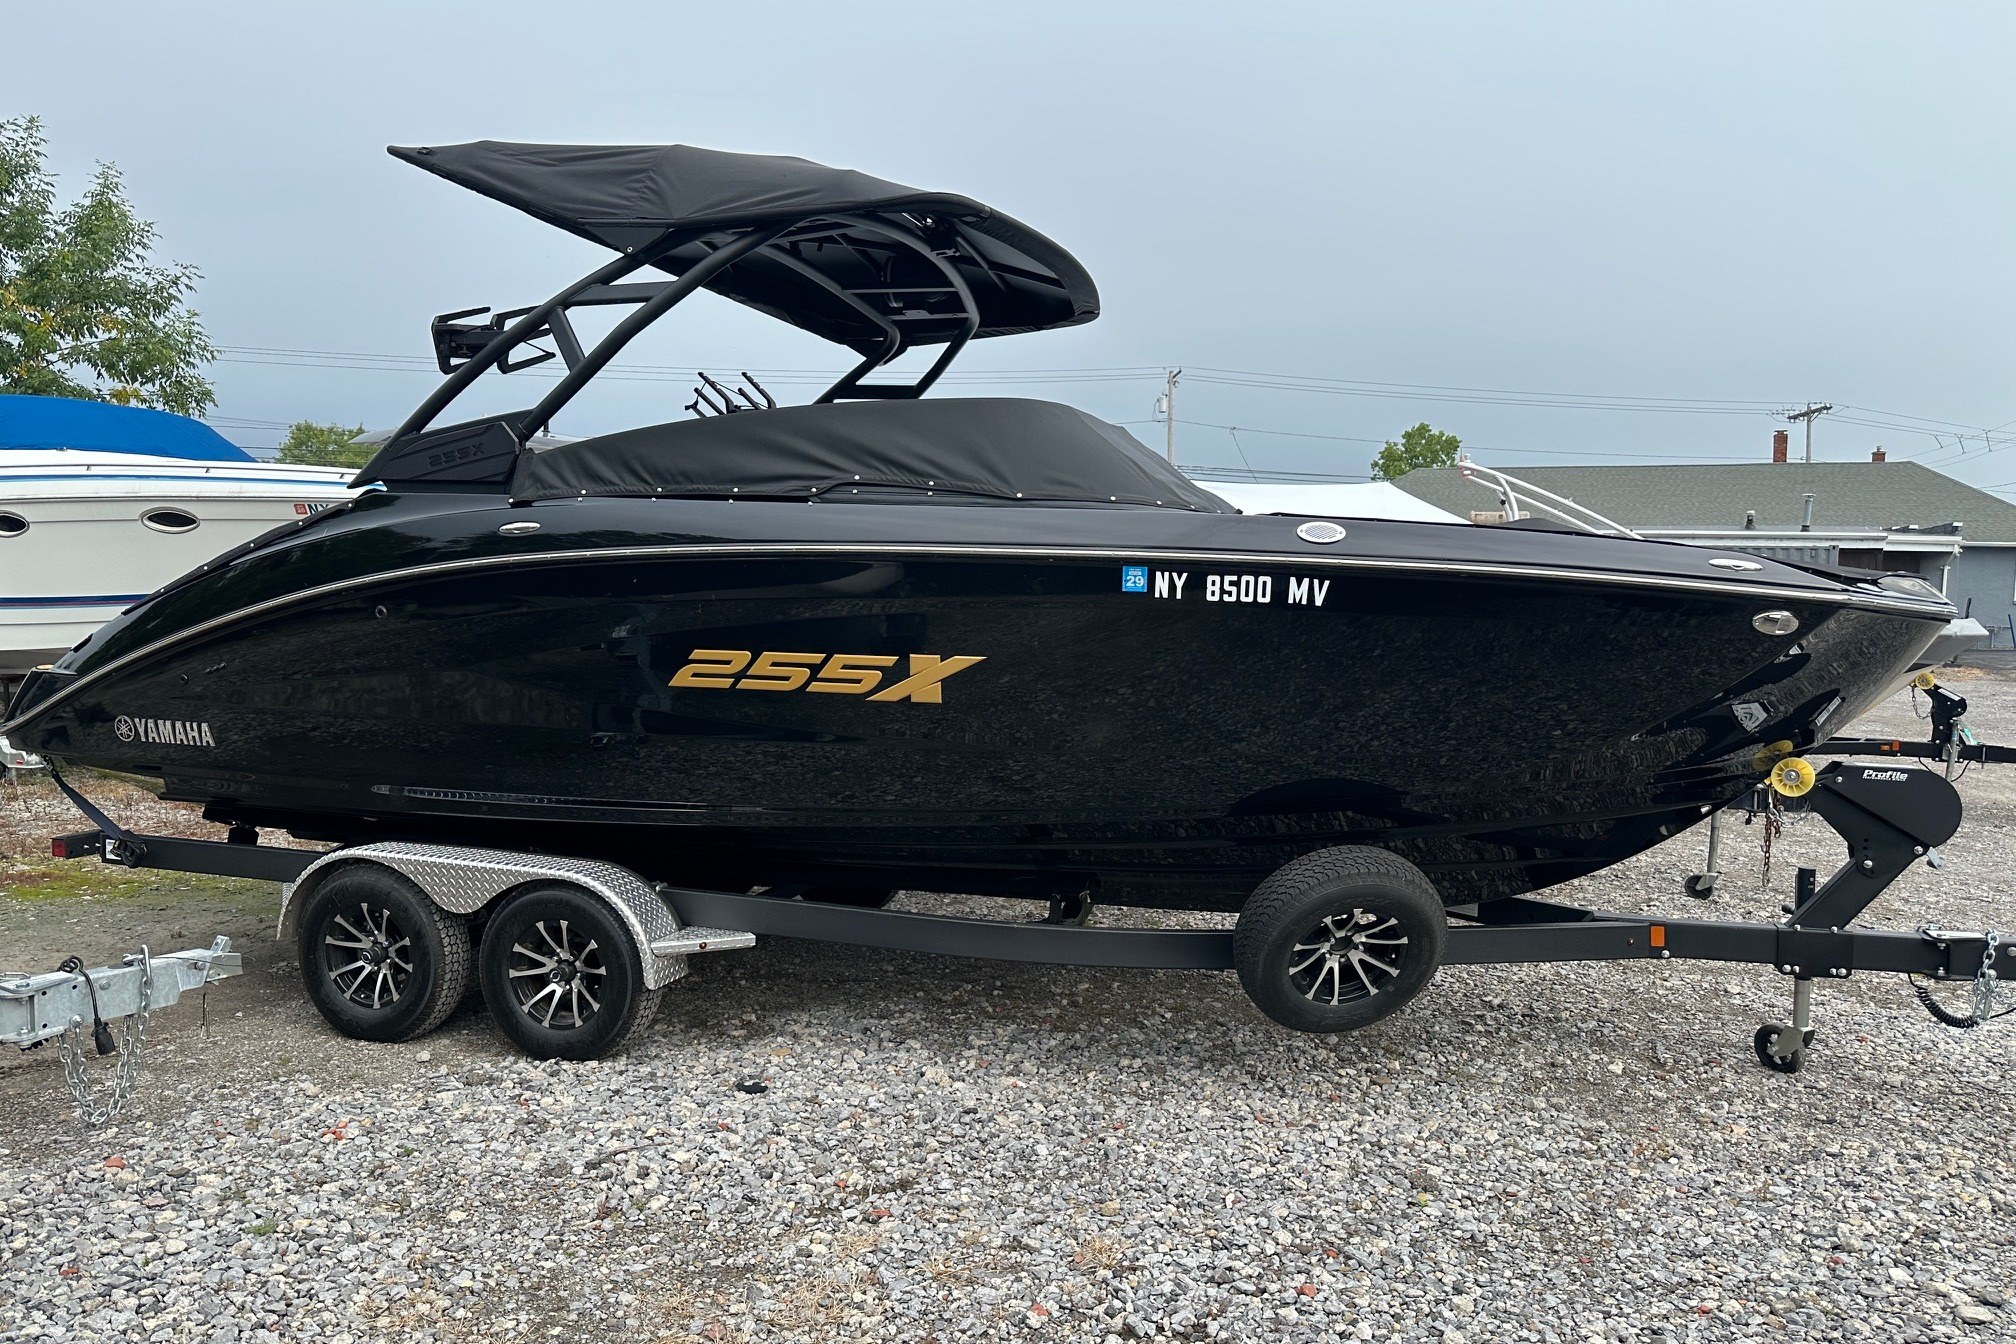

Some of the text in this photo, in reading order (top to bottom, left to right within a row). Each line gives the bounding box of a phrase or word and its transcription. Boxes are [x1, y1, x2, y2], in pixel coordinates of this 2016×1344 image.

[1126, 576, 1144, 587] 29
[1154, 571, 1330, 607] NY 8500 MV
[668, 649, 987, 703] 255X
[134, 718, 215, 747] YAMAHA
[1863, 769, 1908, 780] Profile
